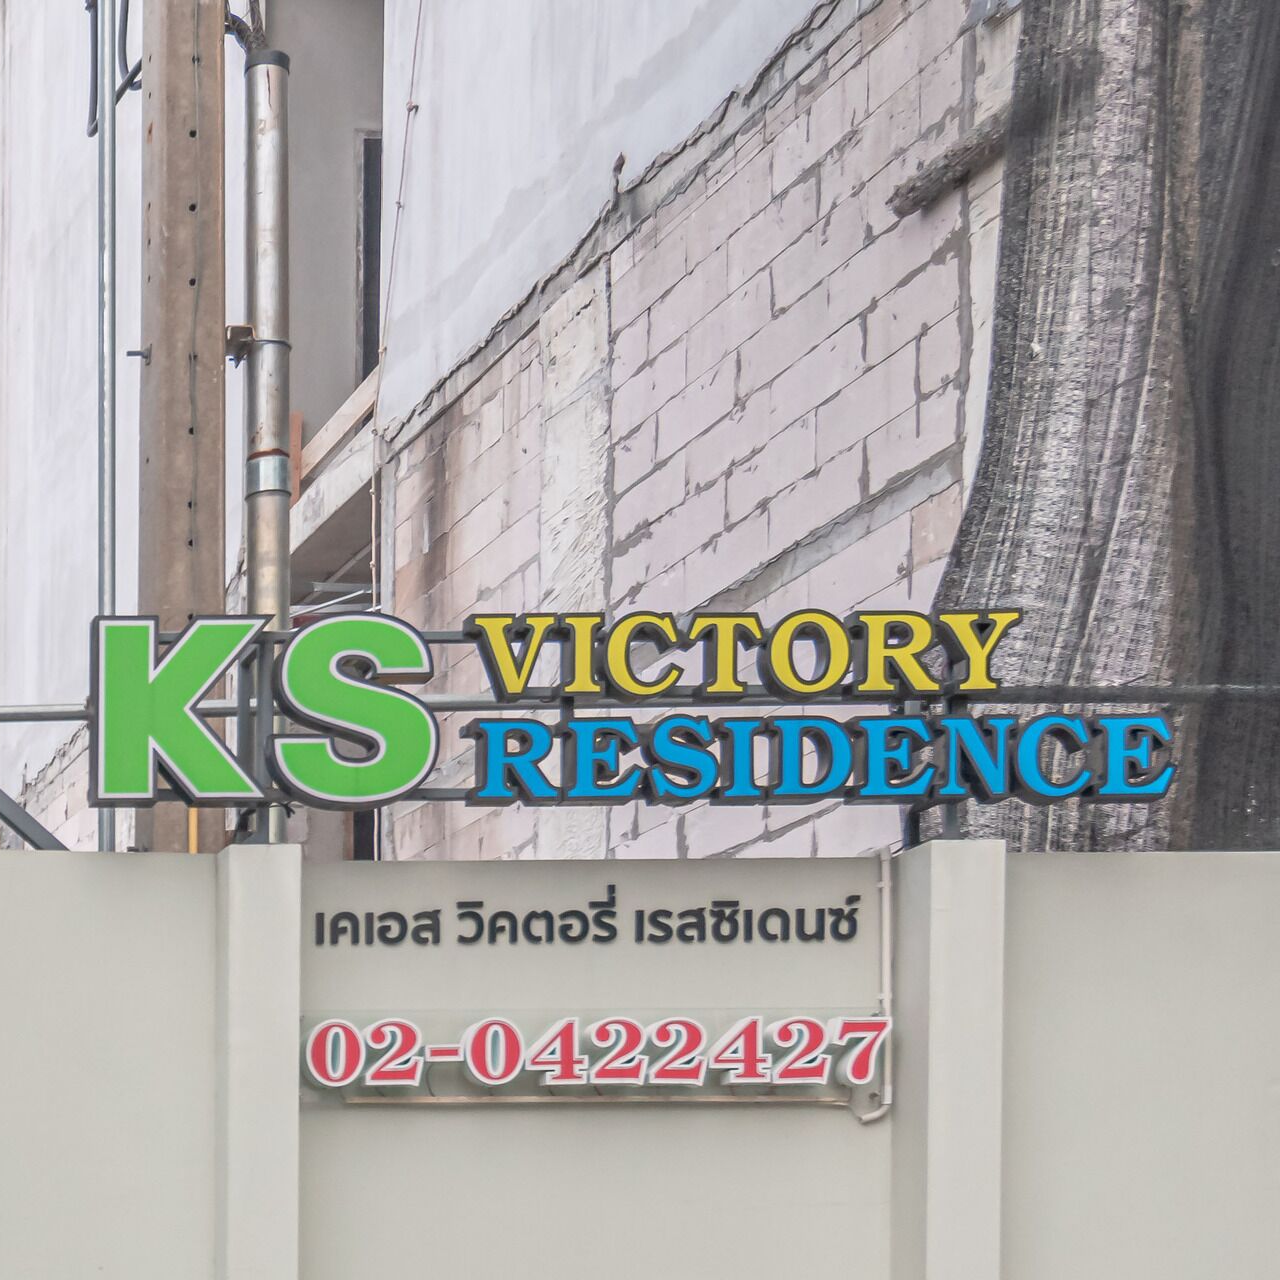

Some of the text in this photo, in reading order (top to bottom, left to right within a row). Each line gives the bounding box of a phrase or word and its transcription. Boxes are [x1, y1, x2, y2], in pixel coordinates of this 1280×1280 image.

[468, 609, 1022, 698] VICTORY
[90, 612, 440, 809] KS
[465, 714, 1180, 803] RESIDENCE
[313, 884, 862, 947] เคเอส วิคตอรี่ เรสซิเดนซ์
[306, 1016, 893, 1087] 02-0422427
